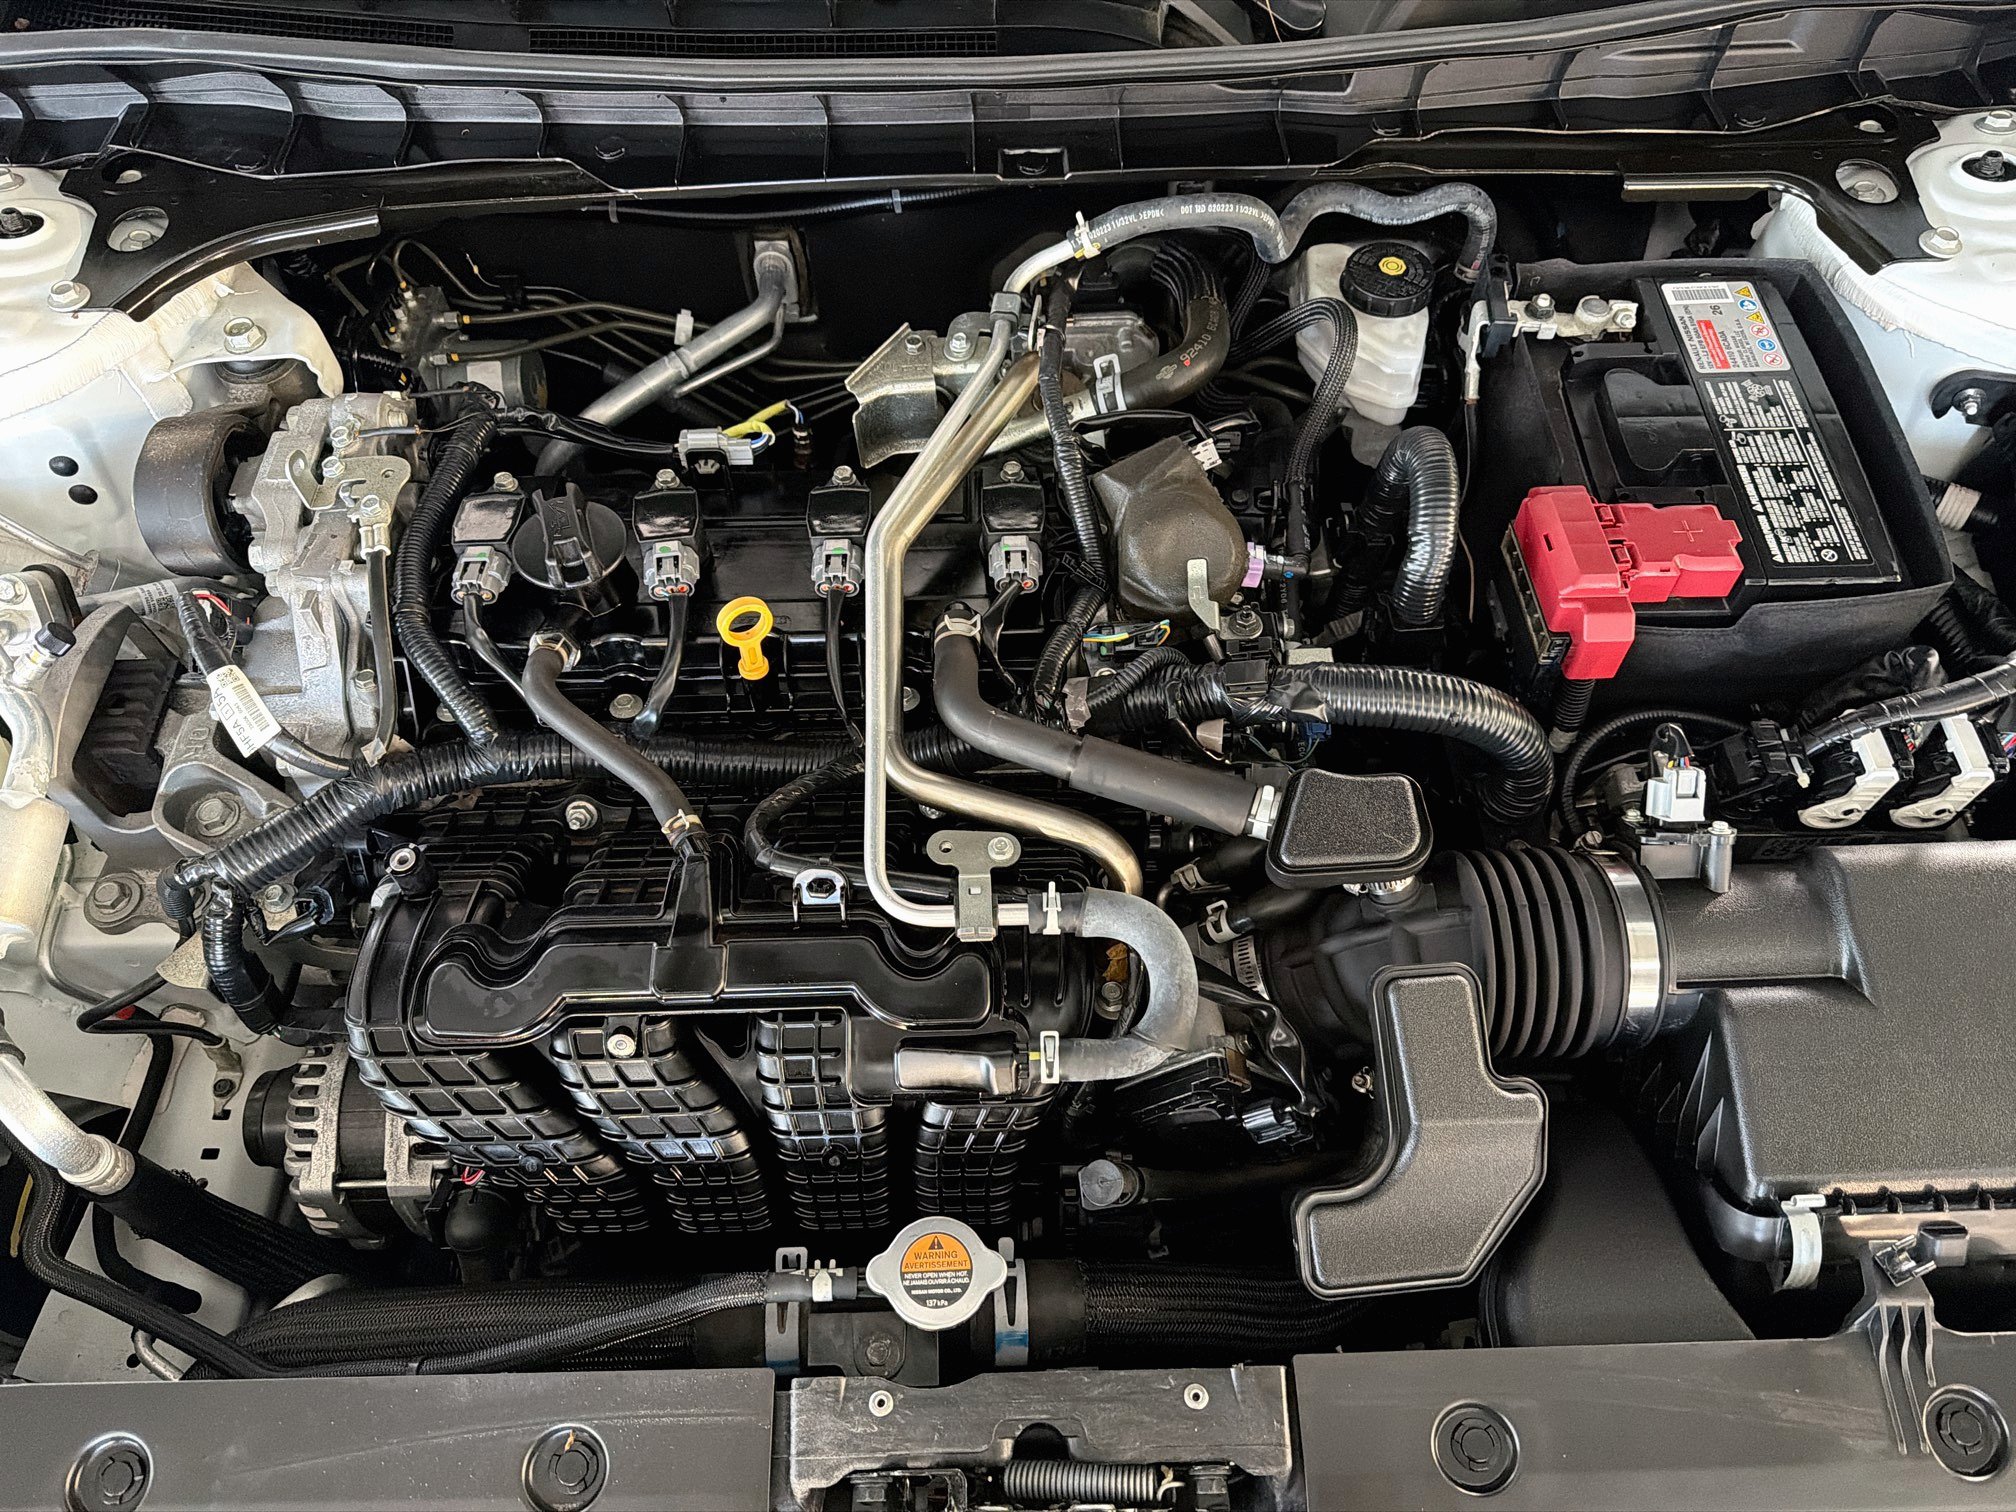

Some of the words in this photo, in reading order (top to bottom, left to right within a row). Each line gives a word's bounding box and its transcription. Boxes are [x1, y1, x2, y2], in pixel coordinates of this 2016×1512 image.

[1208, 204, 1234, 213] 020223
[1710, 305, 1722, 315] 26
[1678, 316, 1694, 341] NISSAN
[1180, 334, 1211, 361] 92410
[214, 687, 226, 706] 5A
[914, 1250, 958, 1260] WARNING
[904, 1260, 968, 1270] AVERTISSEMENT
